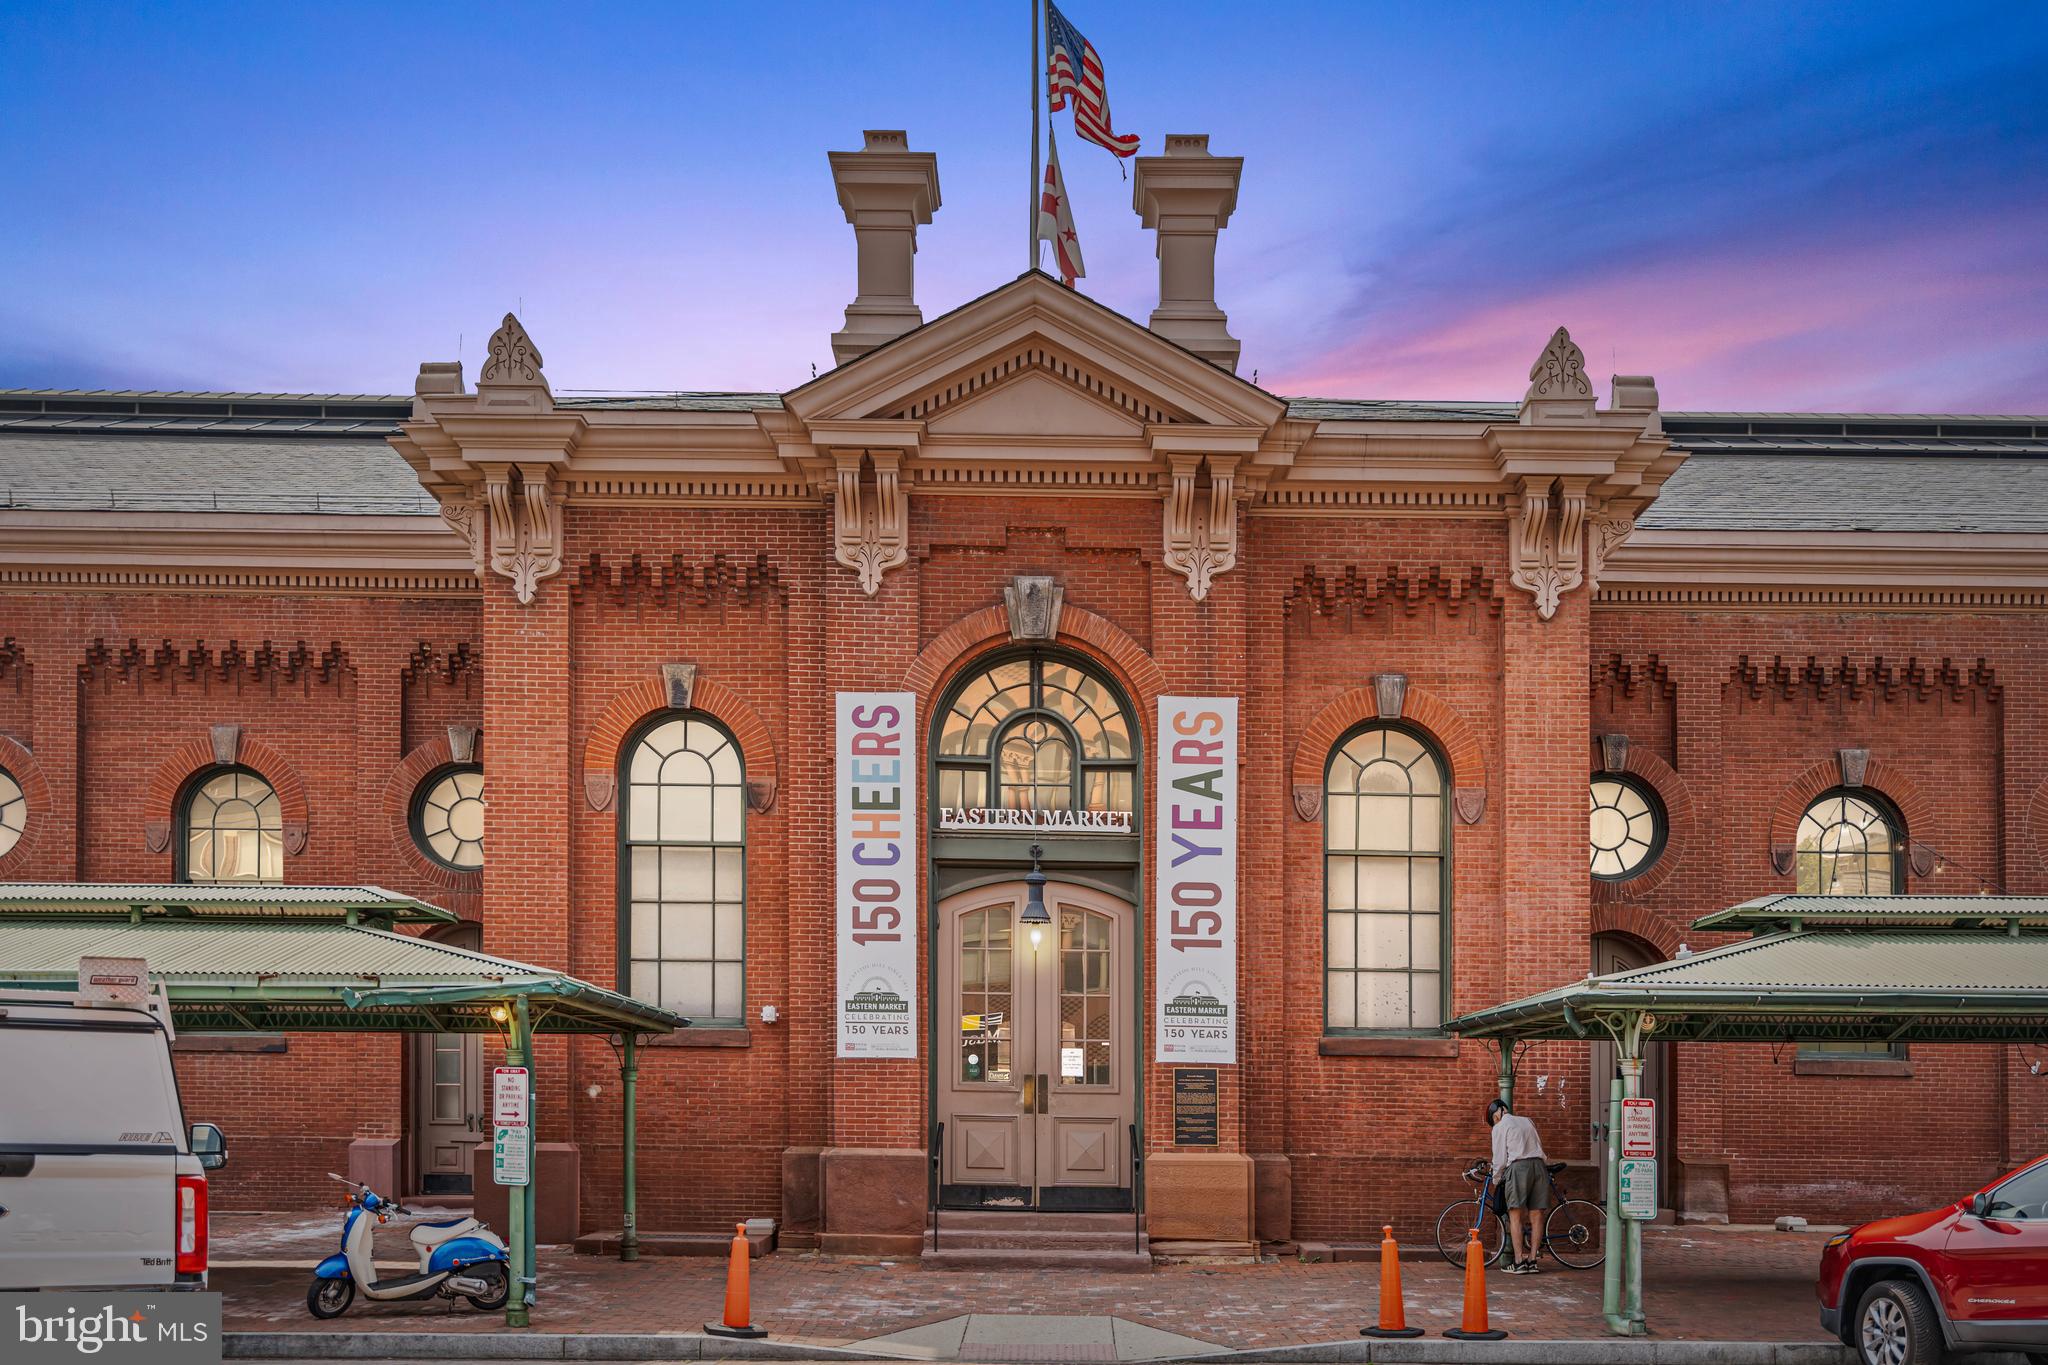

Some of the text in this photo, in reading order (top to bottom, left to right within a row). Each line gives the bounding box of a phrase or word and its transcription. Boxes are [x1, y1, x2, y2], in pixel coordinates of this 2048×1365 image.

[940, 807, 1132, 829] EASTERN MARKET
[851, 704, 901, 947] 150 CHEERS
[1171, 711, 1224, 953] 150 YEARS
[879, 1003, 907, 1011] MARKET
[1198, 1007, 1226, 1015] MARKET
[1164, 1017, 1228, 1025] CELEBRATING
[845, 1025, 909, 1035] 150 YEARS
[1164, 1029, 1228, 1039] 150 YEARS
[140, 1257, 155, 1266] Ted
